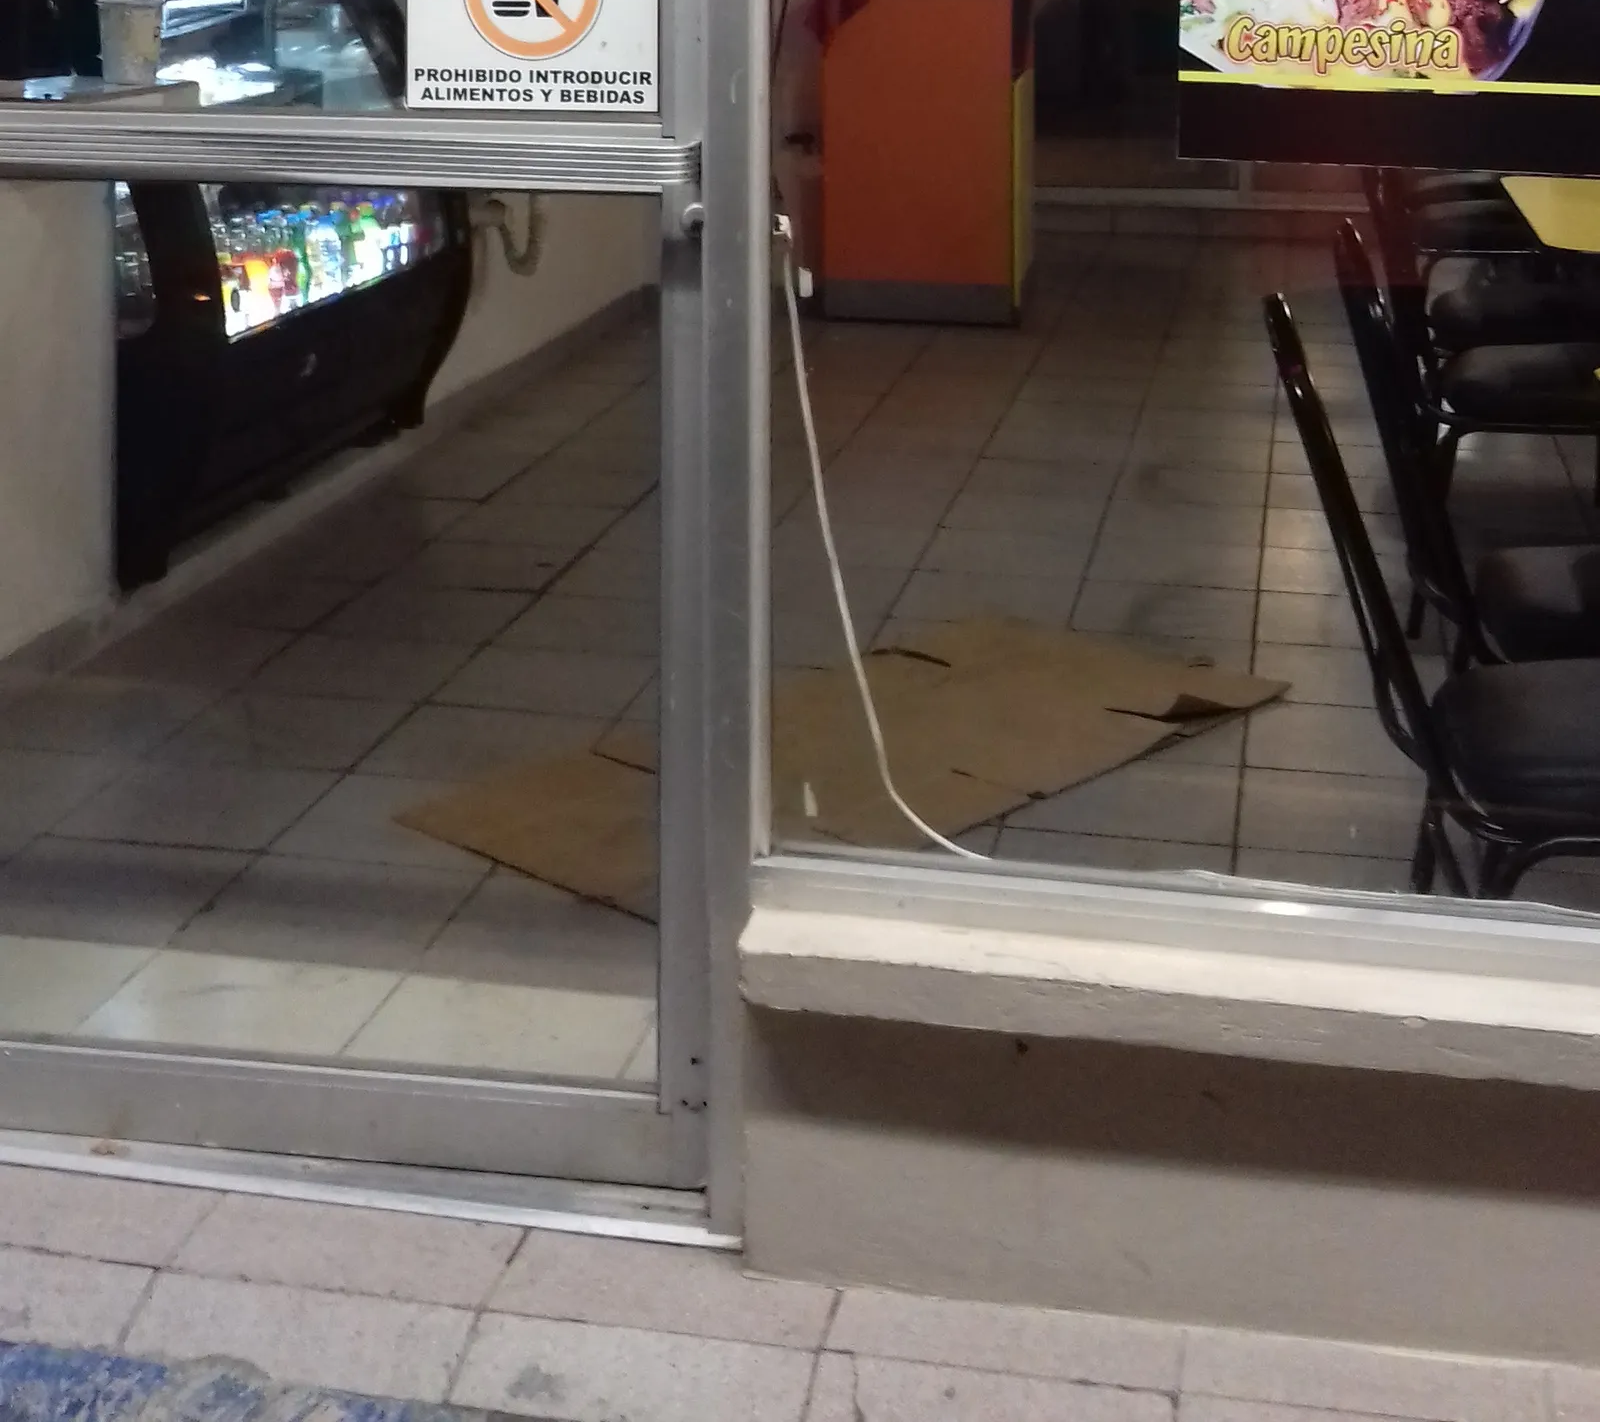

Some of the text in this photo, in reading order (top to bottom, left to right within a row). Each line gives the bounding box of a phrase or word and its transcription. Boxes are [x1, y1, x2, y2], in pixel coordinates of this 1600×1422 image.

[1227, 16, 1460, 71] Campesina
[414, 68, 652, 85] PROHIBIDO INTRODUCIR
[420, 88, 645, 104] ALIMENTOS Y BEBIDAS
